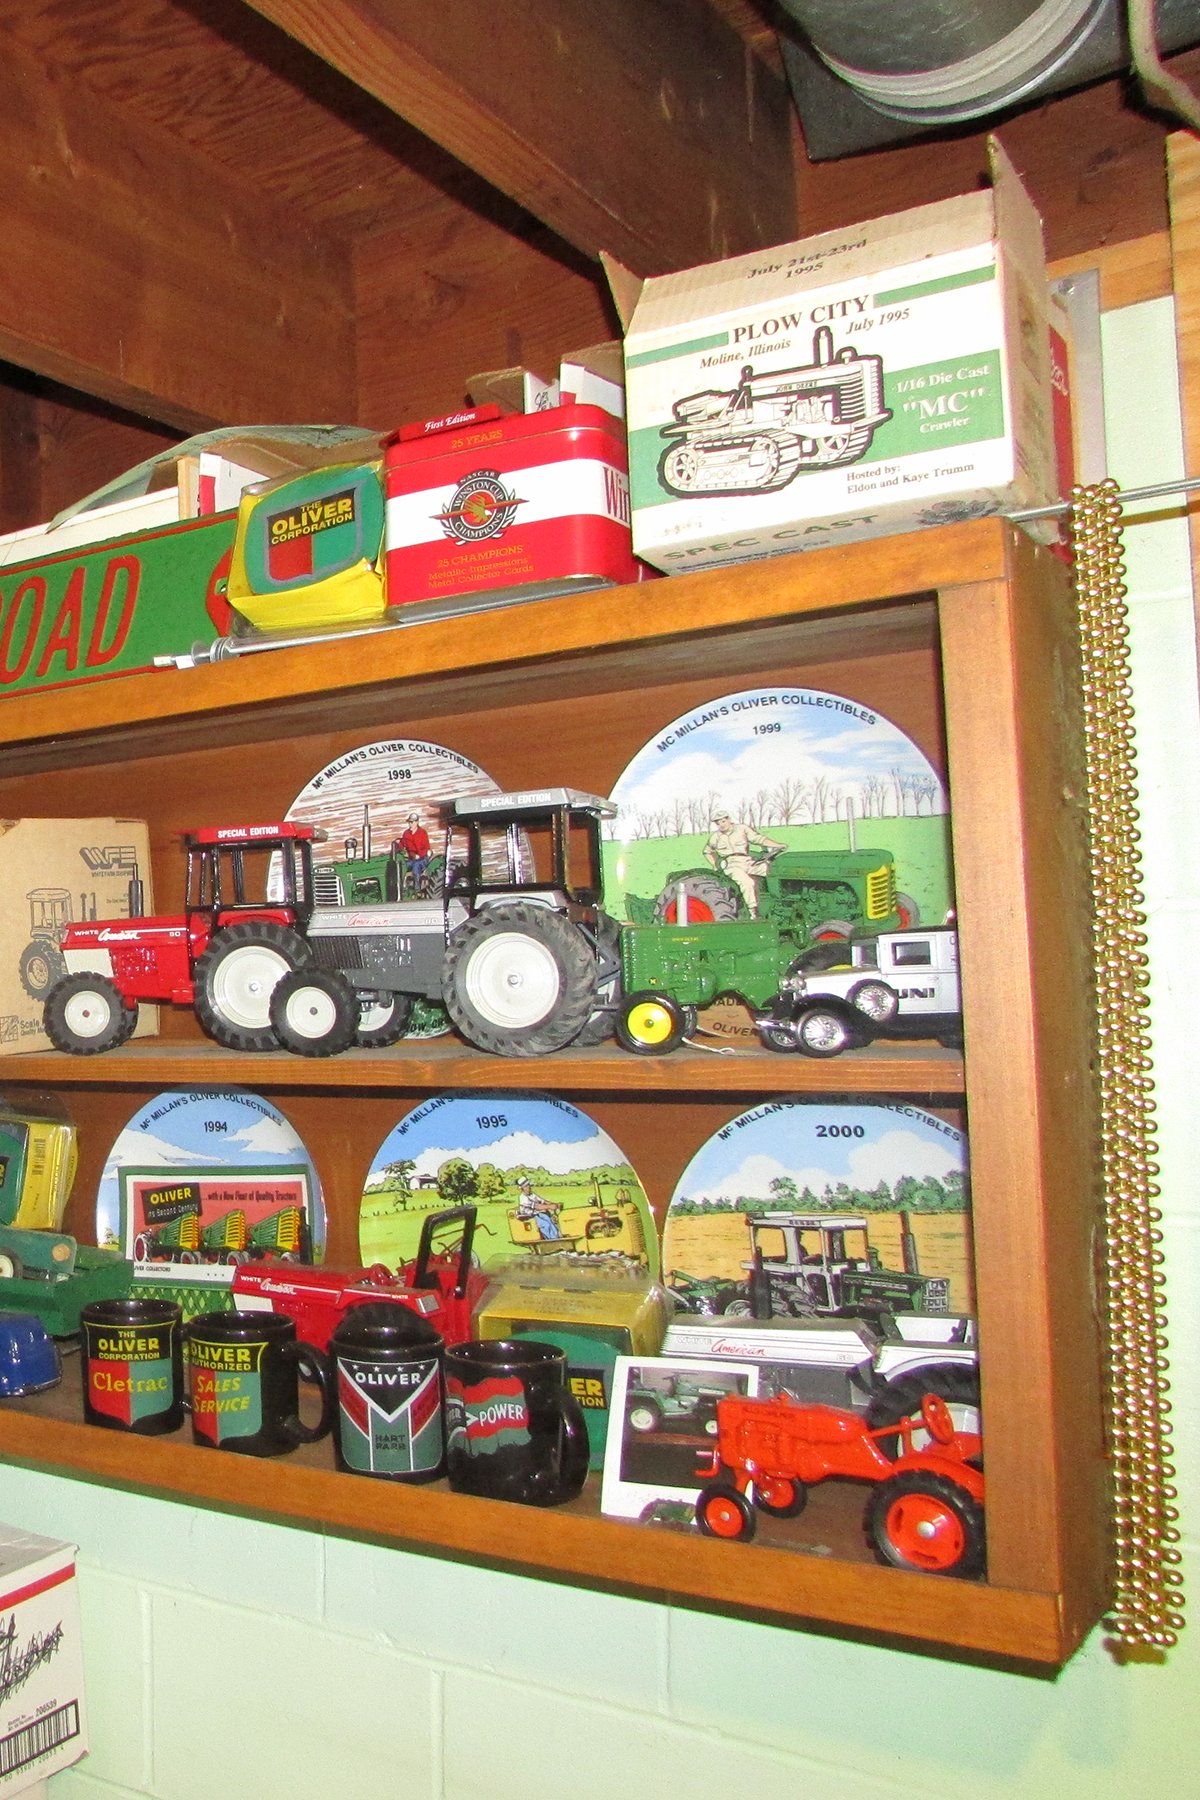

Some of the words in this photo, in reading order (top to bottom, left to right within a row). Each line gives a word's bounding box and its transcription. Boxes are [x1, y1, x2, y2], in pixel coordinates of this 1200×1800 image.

[748, 261, 783, 278] July
[787, 238, 867, 268] 21st-23rd
[785, 261, 824, 279] 1995
[732, 311, 802, 344] PLOW
[809, 294, 870, 323] CITY
[846, 317, 874, 335] July
[878, 307, 910, 326] 1995
[700, 346, 744, 370] Moline,
[748, 337, 791, 358] Illinois
[896, 376, 926, 394] 1/16
[929, 370, 953, 386] Die
[956, 363, 991, 379] Cast
[902, 387, 984, 420] "MC"
[424, 419, 444, 433] First
[445, 411, 476, 429] Edition
[919, 416, 970, 434] Crawler
[451, 437, 464, 449] 25
[466, 428, 504, 447] YEARS
[460, 471, 495, 485] NASCAR
[846, 468, 882, 482] Hosted
[884, 463, 901, 477] by:
[847, 482, 877, 494] Eldon
[880, 478, 900, 490] and
[902, 471, 929, 485] Kaye
[933, 463, 975, 478] Trumm
[454, 481, 490, 507] WINSTON
[490, 484, 504, 500] CUP
[301, 502, 321, 512] THE
[272, 497, 354, 537] OLIVER
[455, 512, 503, 538] CHAMPIONS
[271, 511, 354, 547] CORPORATION
[663, 538, 761, 561] SPEC
[772, 514, 879, 540] CAST
[438, 559, 450, 568] 25
[451, 544, 524, 565] CHAMPIONS
[428, 577, 455, 589] Metal
[458, 571, 501, 584] Collector
[504, 564, 534, 576] Cards
[429, 567, 466, 580] Metallic
[469, 557, 528, 573] Impressions
[674, 705, 729, 739] MILLAN'S
[731, 695, 778, 712] OLIVER
[780, 694, 877, 726] COLLECTIBLES
[752, 722, 781, 735] 1999
[324, 750, 367, 778] MILLAN'S
[369, 742, 405, 756] OLIVER
[408, 742, 479, 773] COLLECTIBLES
[388, 768, 412, 781] 1998
[480, 796, 515, 808] SPECIAL
[517, 792, 551, 805] EDITION
[217, 827, 248, 839] SPECIAL
[249, 825, 279, 836] EDITION
[74, 929, 99, 937] WHITE
[20, 1018, 40, 1029] Scale
[151, 1097, 188, 1121] MILLAN'S
[189, 1091, 221, 1103] OLIVER
[223, 1092, 285, 1128] COLLECTIBLES
[410, 1096, 454, 1125] MILLAN'S
[735, 1102, 795, 1129] MILLAN'S
[204, 1120, 228, 1133] 1994
[476, 1114, 509, 1130] 1995
[815, 1124, 865, 1138] 2000
[150, 1186, 192, 1205] OLIVER
[241, 1275, 261, 1283] WHITE
[118, 1330, 136, 1338] THE
[98, 1337, 160, 1352] OLIVER
[190, 1345, 251, 1361] OLIVER
[711, 1338, 768, 1356] American
[98, 1352, 160, 1361] CORPORATION
[93, 1371, 169, 1393] Cletrac
[197, 1375, 242, 1394] SALES
[355, 1372, 421, 1386] OLIVER
[193, 1395, 251, 1413] SERVICE
[479, 1402, 524, 1427] POWER
[375, 1434, 406, 1442] HART
[375, 1442, 406, 1450] PARR
